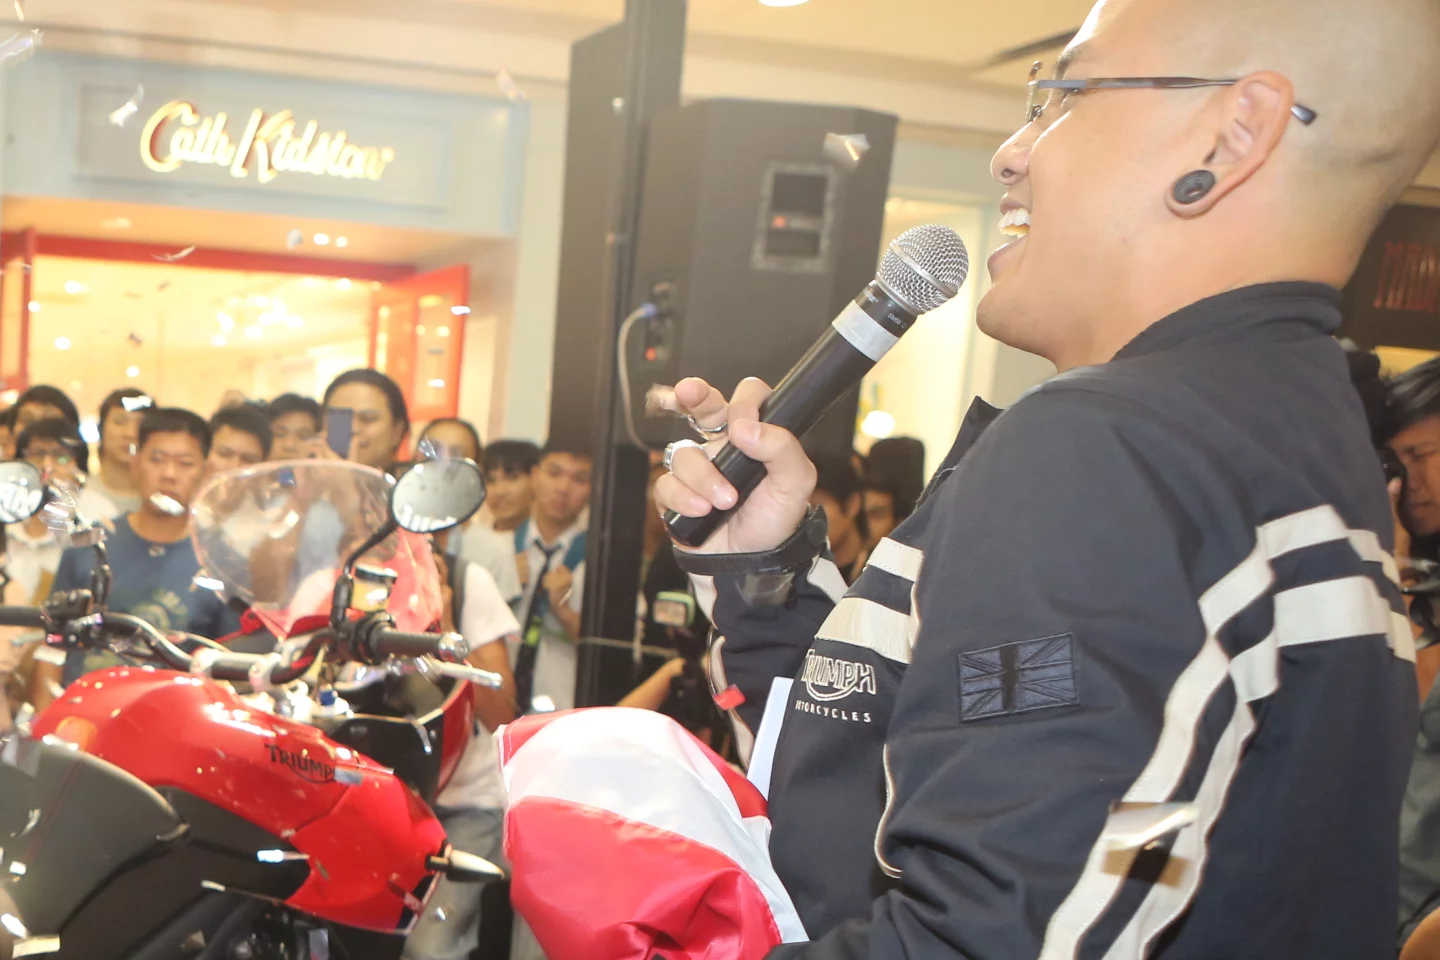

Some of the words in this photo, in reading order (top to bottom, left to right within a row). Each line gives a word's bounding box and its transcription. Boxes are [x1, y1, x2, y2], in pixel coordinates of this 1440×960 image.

[140, 99, 235, 173] Cath
[230, 107, 395, 183] Kidston
[264, 744, 336, 781] TRIUMP
